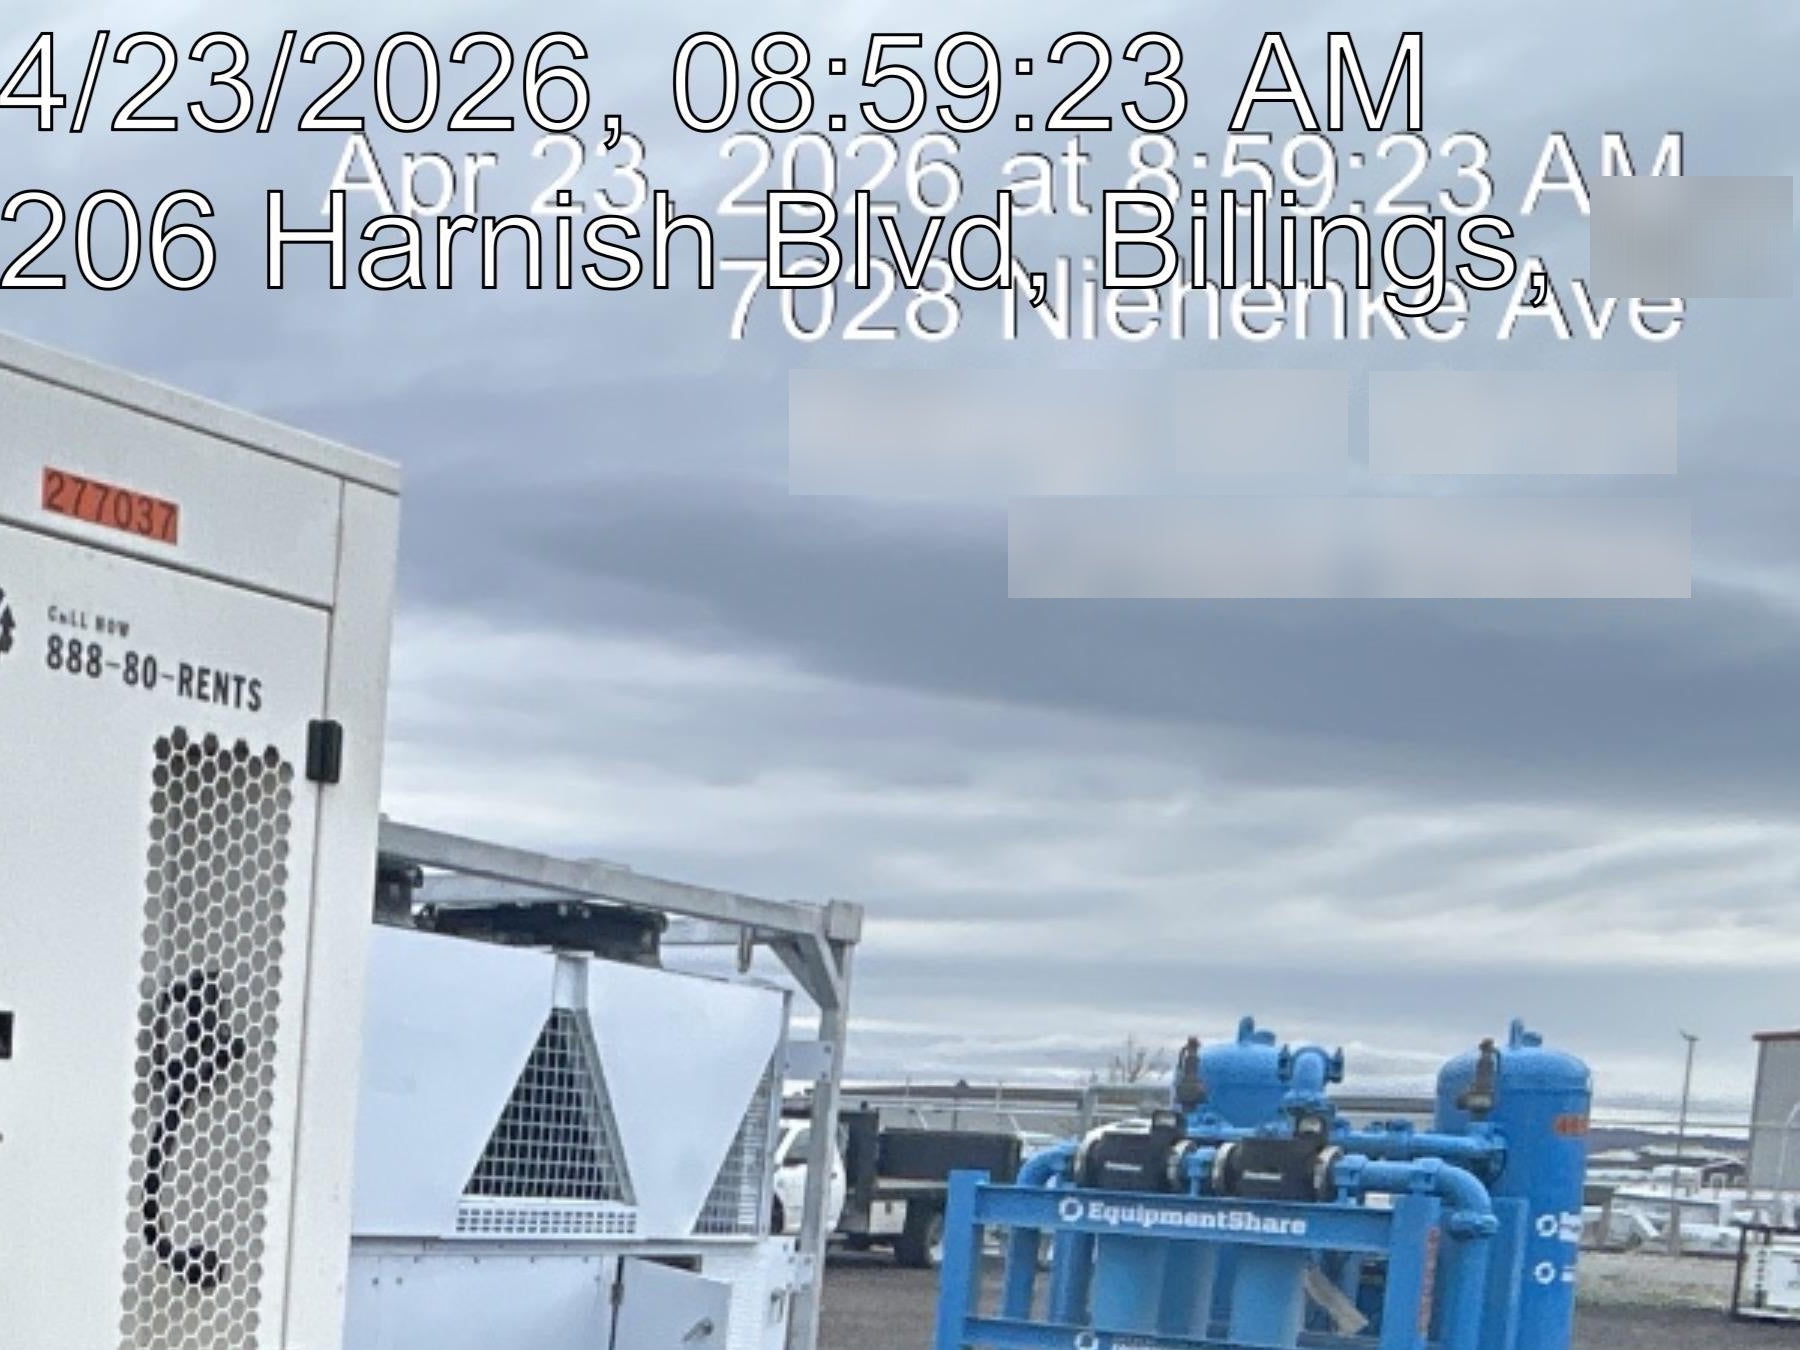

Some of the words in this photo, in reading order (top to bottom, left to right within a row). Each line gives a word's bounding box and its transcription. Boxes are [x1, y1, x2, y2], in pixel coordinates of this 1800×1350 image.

[46, 468, 178, 541] 277037
[46, 633, 263, 713] 888-80-RENTS
[1087, 1200, 1308, 1236] EquipmentShare
